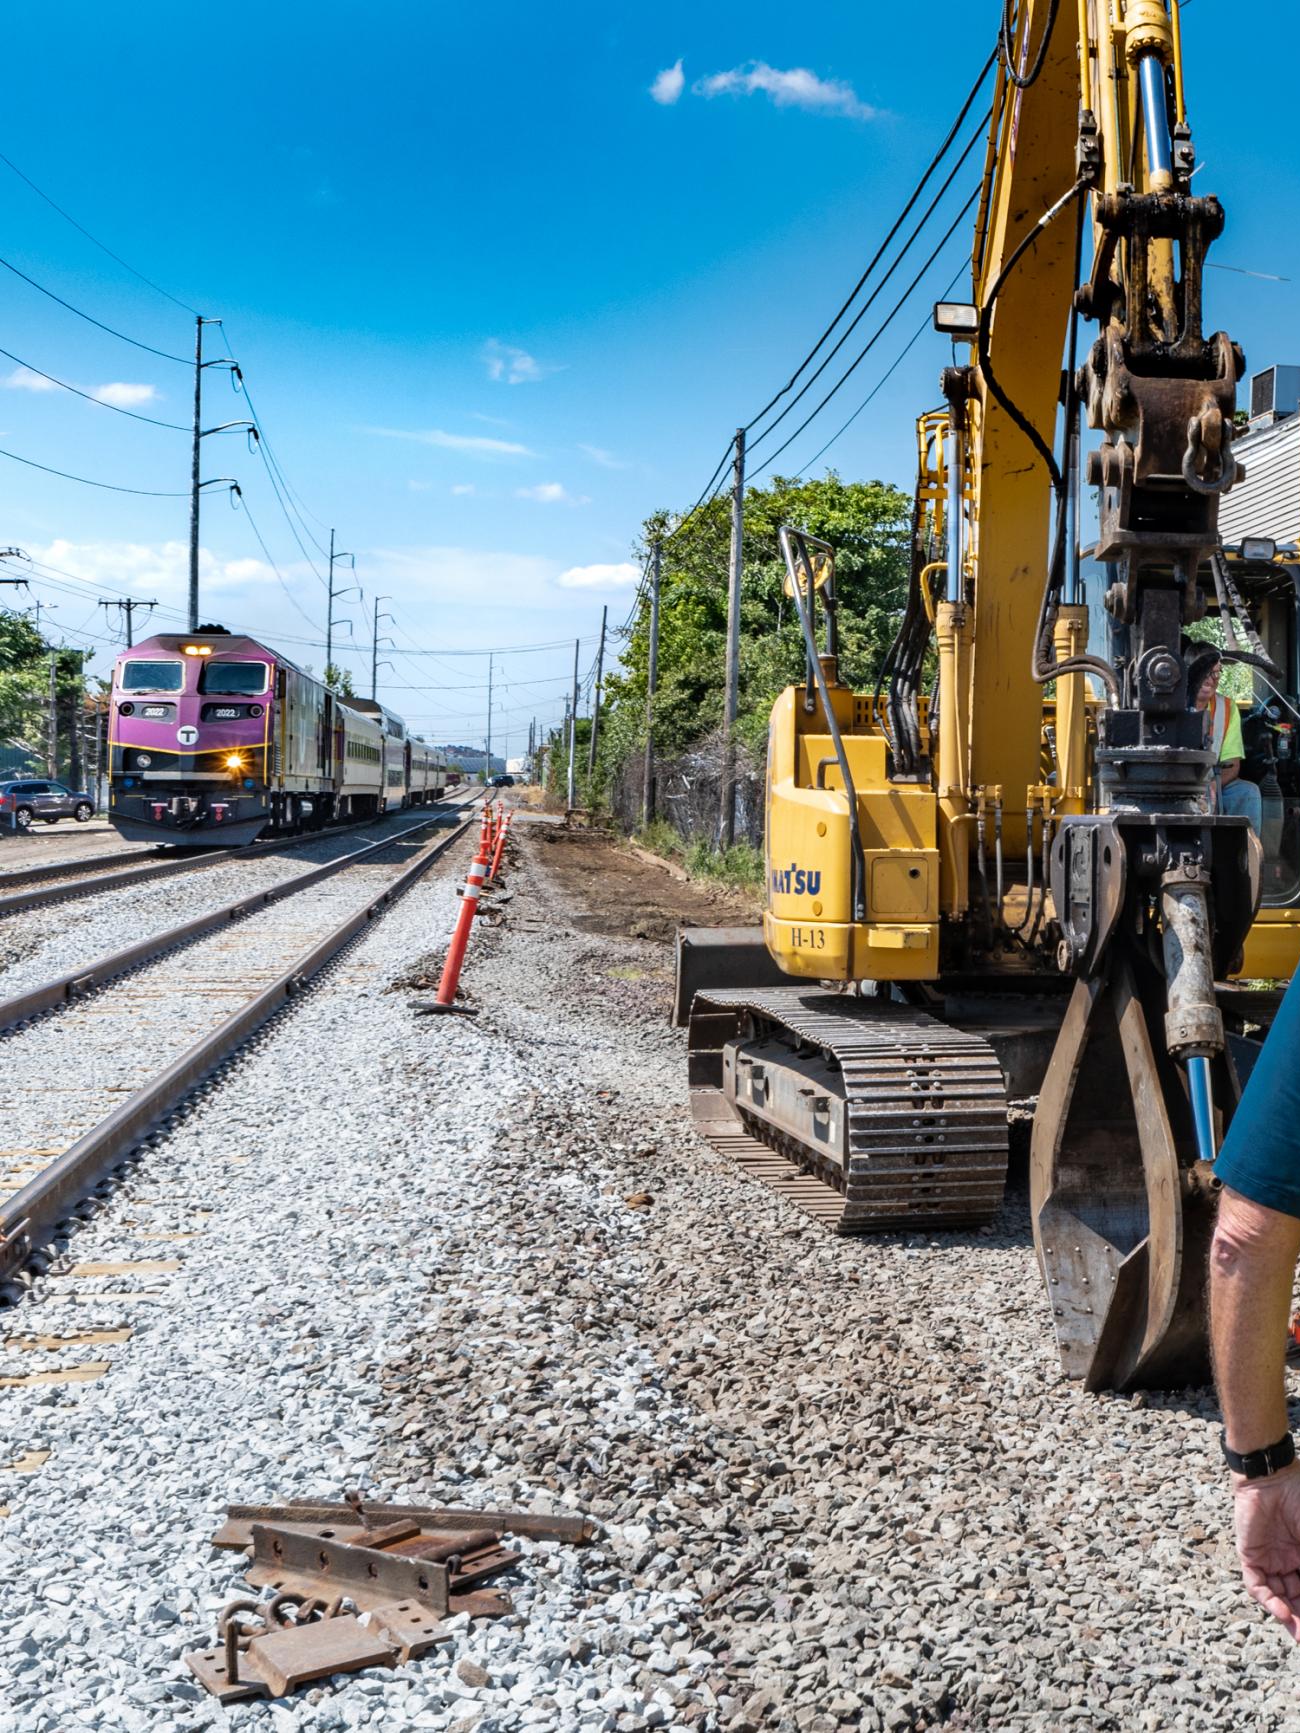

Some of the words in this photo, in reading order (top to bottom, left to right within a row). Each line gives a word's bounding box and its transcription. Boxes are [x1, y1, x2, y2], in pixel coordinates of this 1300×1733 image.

[145, 707, 164, 716] 2022
[216, 708, 236, 717] 2022
[180, 730, 196, 743] T
[792, 927, 825, 949] H-13
